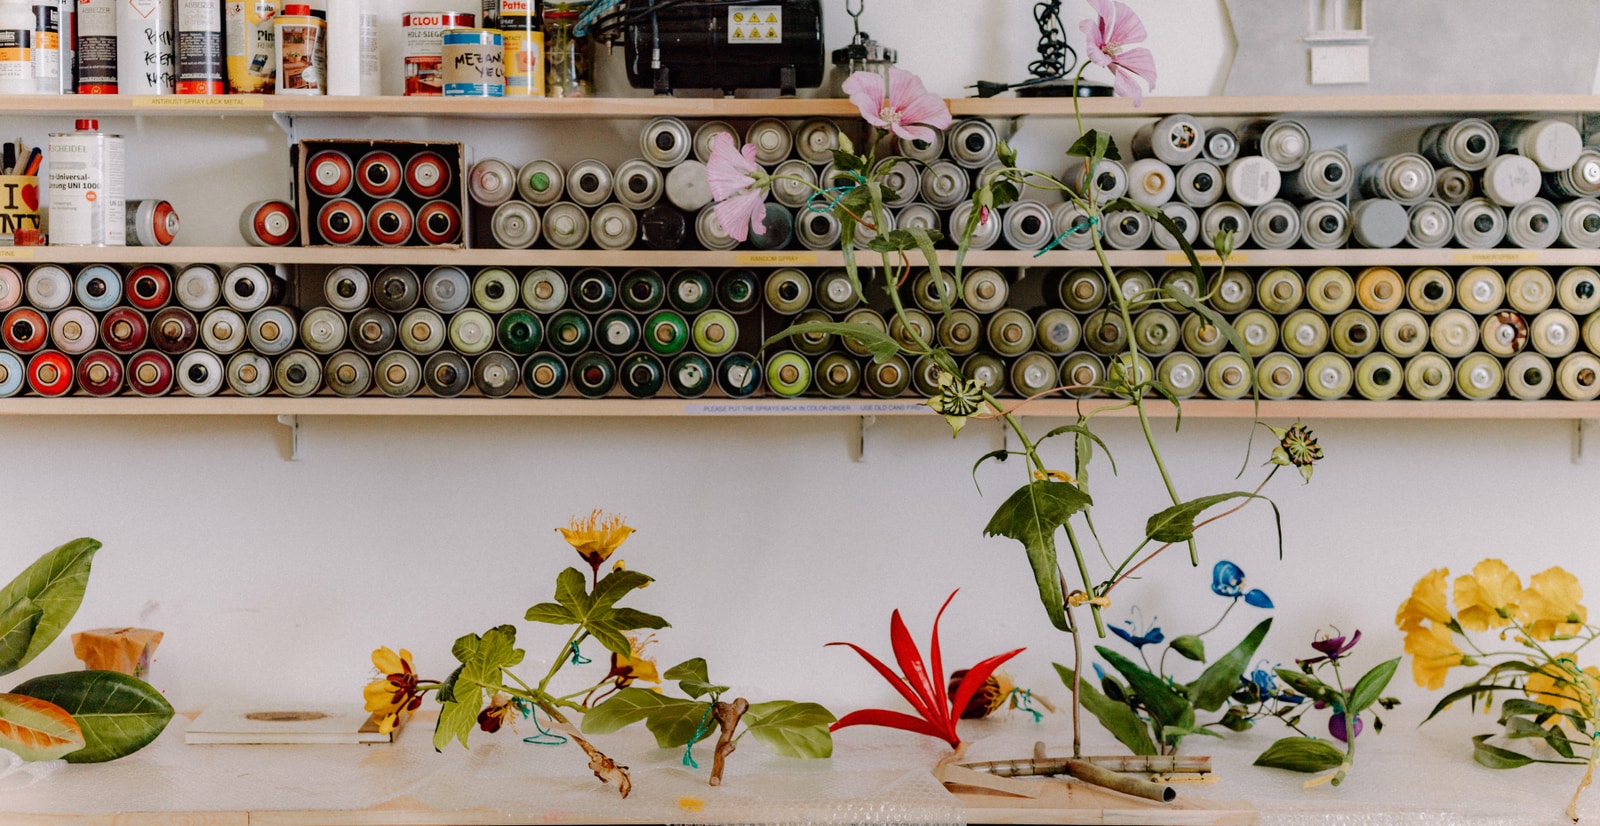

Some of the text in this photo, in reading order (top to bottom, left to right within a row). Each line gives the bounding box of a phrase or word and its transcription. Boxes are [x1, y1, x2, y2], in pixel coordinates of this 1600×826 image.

[502, 0, 530, 9] Patte
[412, 16, 439, 26] CLOU
[4, 183, 19, 210] I
